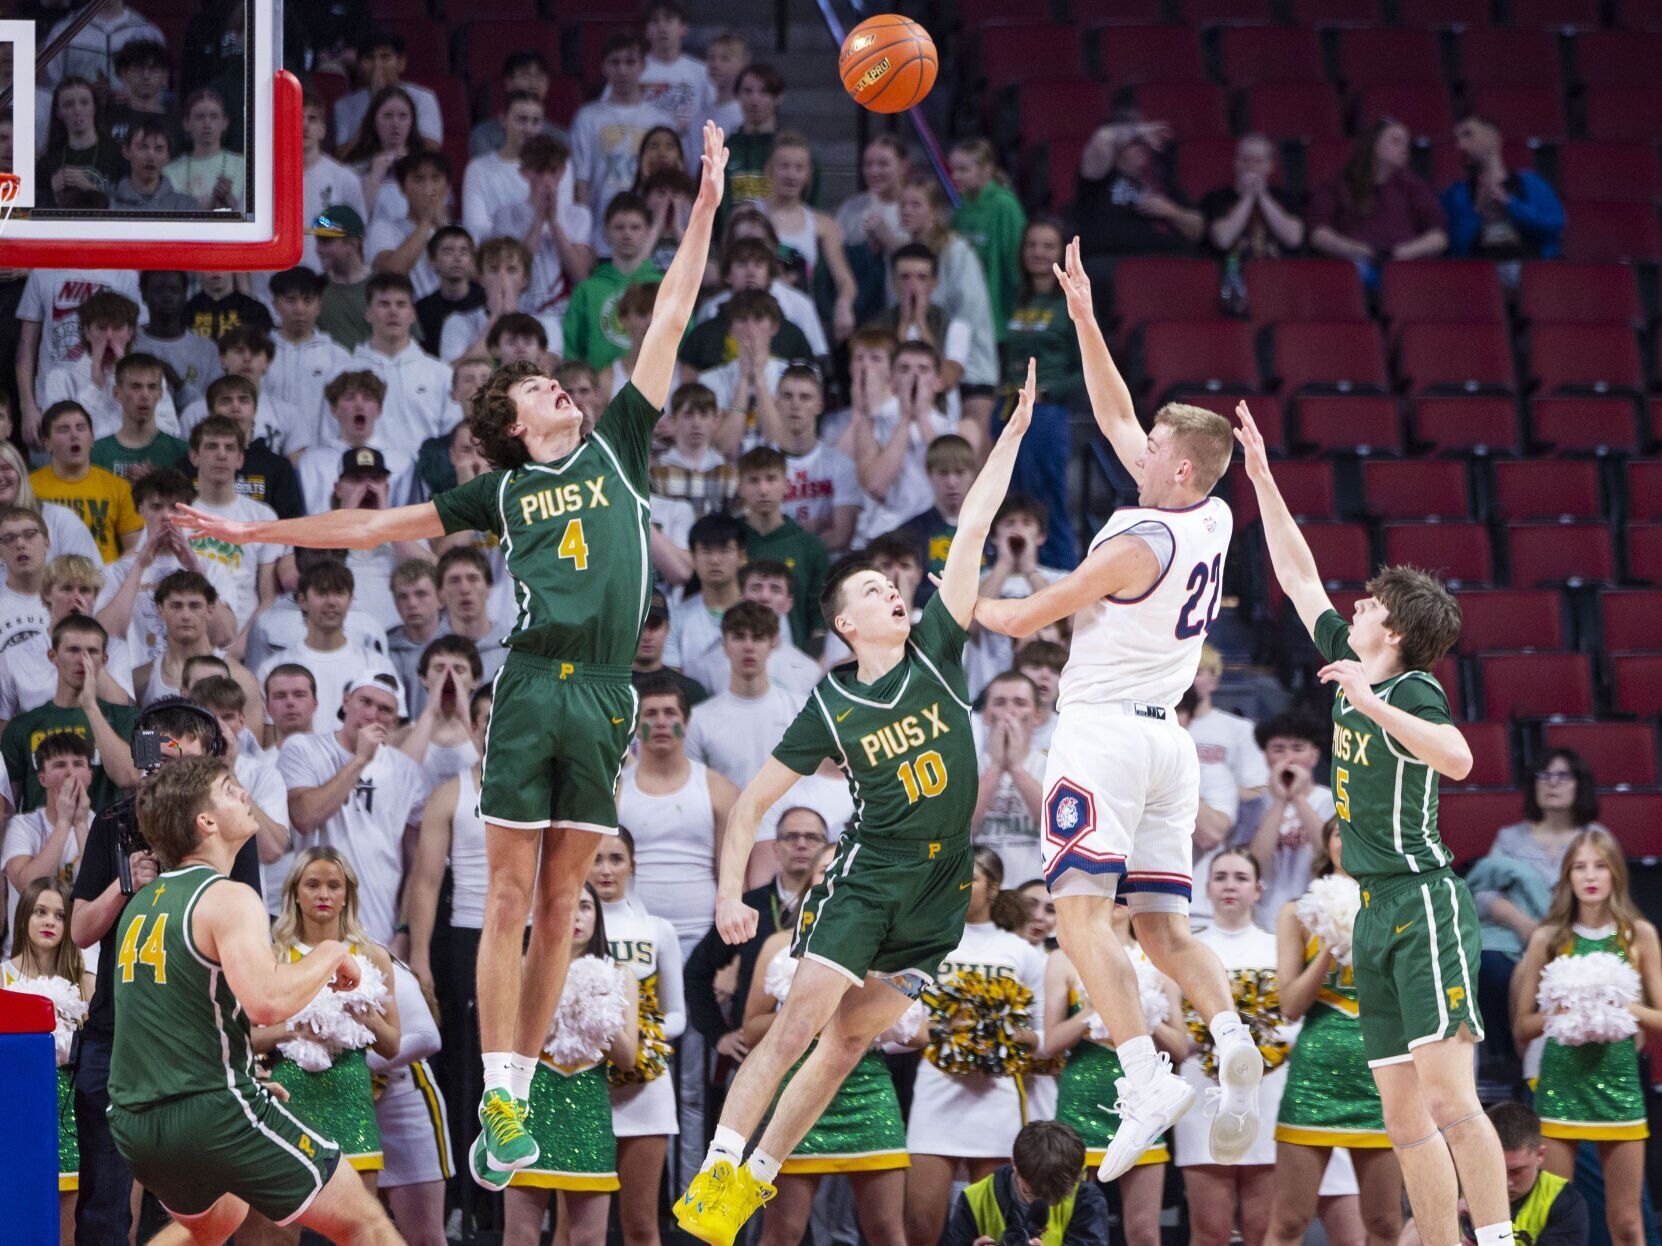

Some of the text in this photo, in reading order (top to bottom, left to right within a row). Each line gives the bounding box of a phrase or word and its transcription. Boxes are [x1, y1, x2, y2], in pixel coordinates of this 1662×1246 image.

[520, 476, 610, 526] PIUS X
[558, 518, 588, 571] 4
[860, 702, 950, 768] PIUS X
[1353, 731, 1373, 767] X
[897, 750, 948, 805] 10
[1335, 766, 1351, 822] 5
[117, 912, 169, 984] 44
[608, 940, 653, 965] US
[1446, 986, 1465, 1010] P
